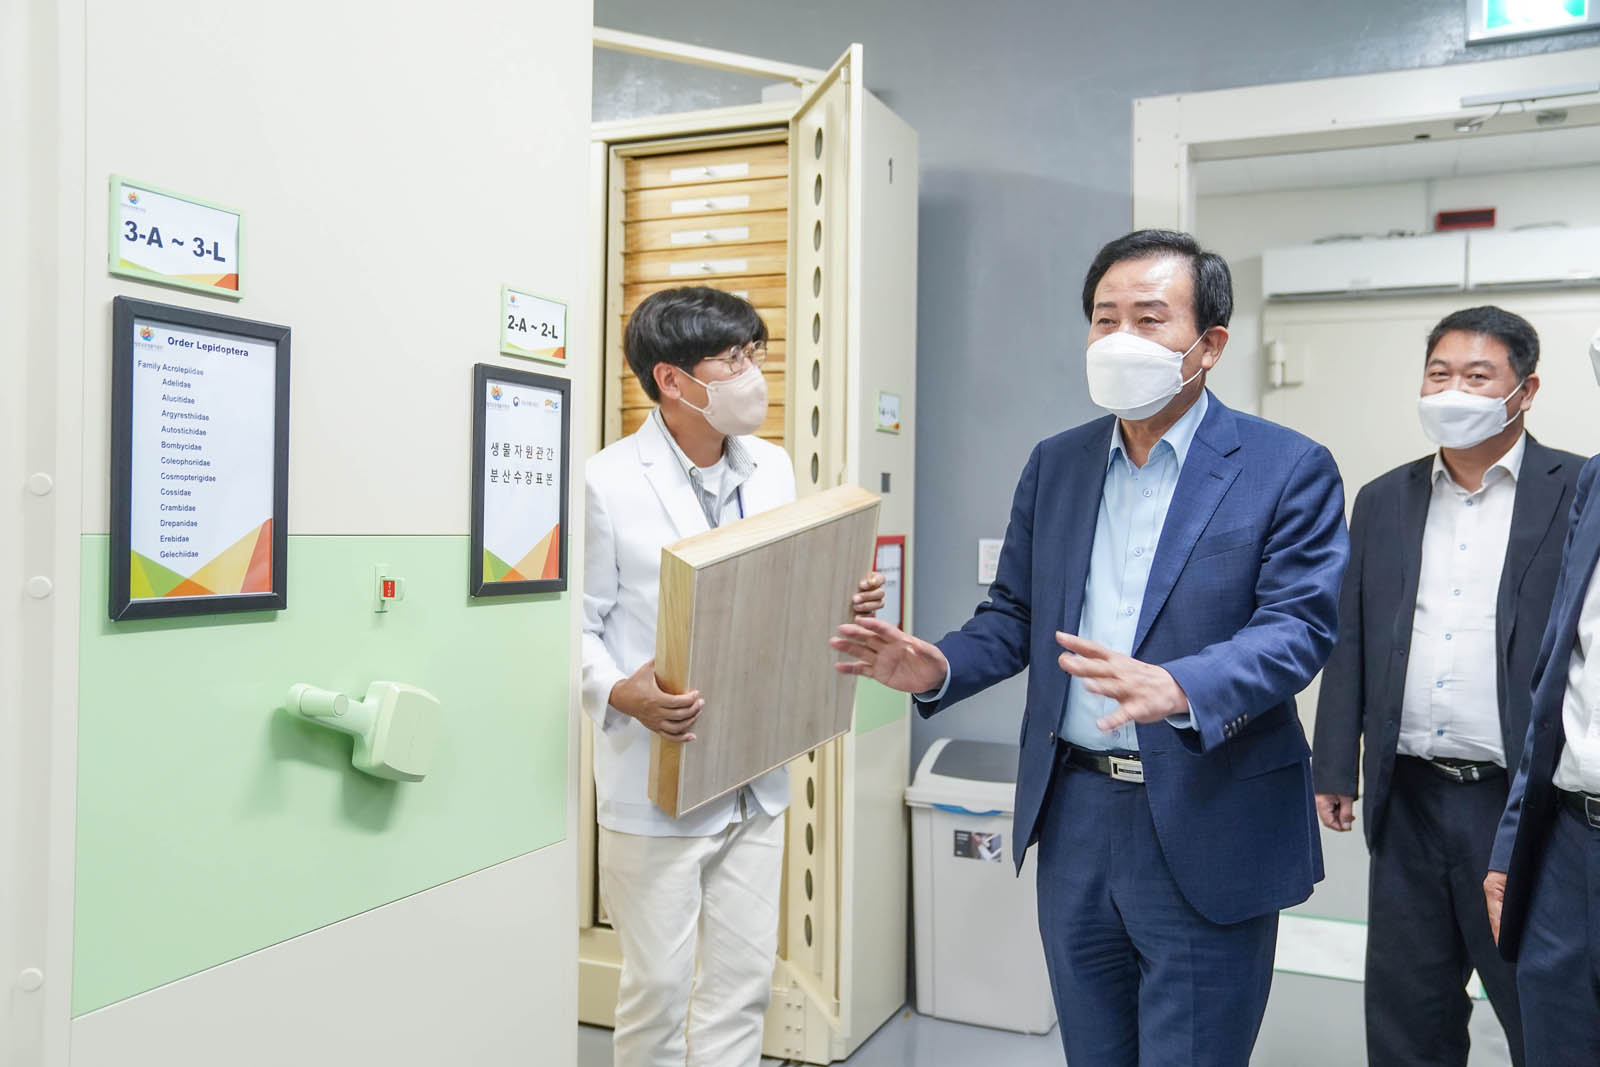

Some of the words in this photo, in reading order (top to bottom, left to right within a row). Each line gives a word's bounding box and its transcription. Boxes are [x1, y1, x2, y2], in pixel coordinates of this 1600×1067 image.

[124, 220, 164, 248] 3-A
[192, 236, 226, 262] 3-L
[507, 314, 528, 332] 2-A
[540, 322, 559, 340] 2-L
[167, 336, 195, 348] Order
[196, 340, 250, 356] Lepidoptera
[137, 360, 161, 372] Family
[162, 378, 192, 388] Adelidae
[160, 426, 207, 436] Autostichidae
[160, 440, 203, 452] Bombycidae
[160, 472, 217, 482] Cosmopterigidae
[160, 488, 192, 496] Cossidae
[159, 504, 196, 512] Crambidae
[159, 520, 198, 528] Drepanidae
[159, 534, 190, 542] Erebidae
[159, 550, 199, 558] Gelechiidae
